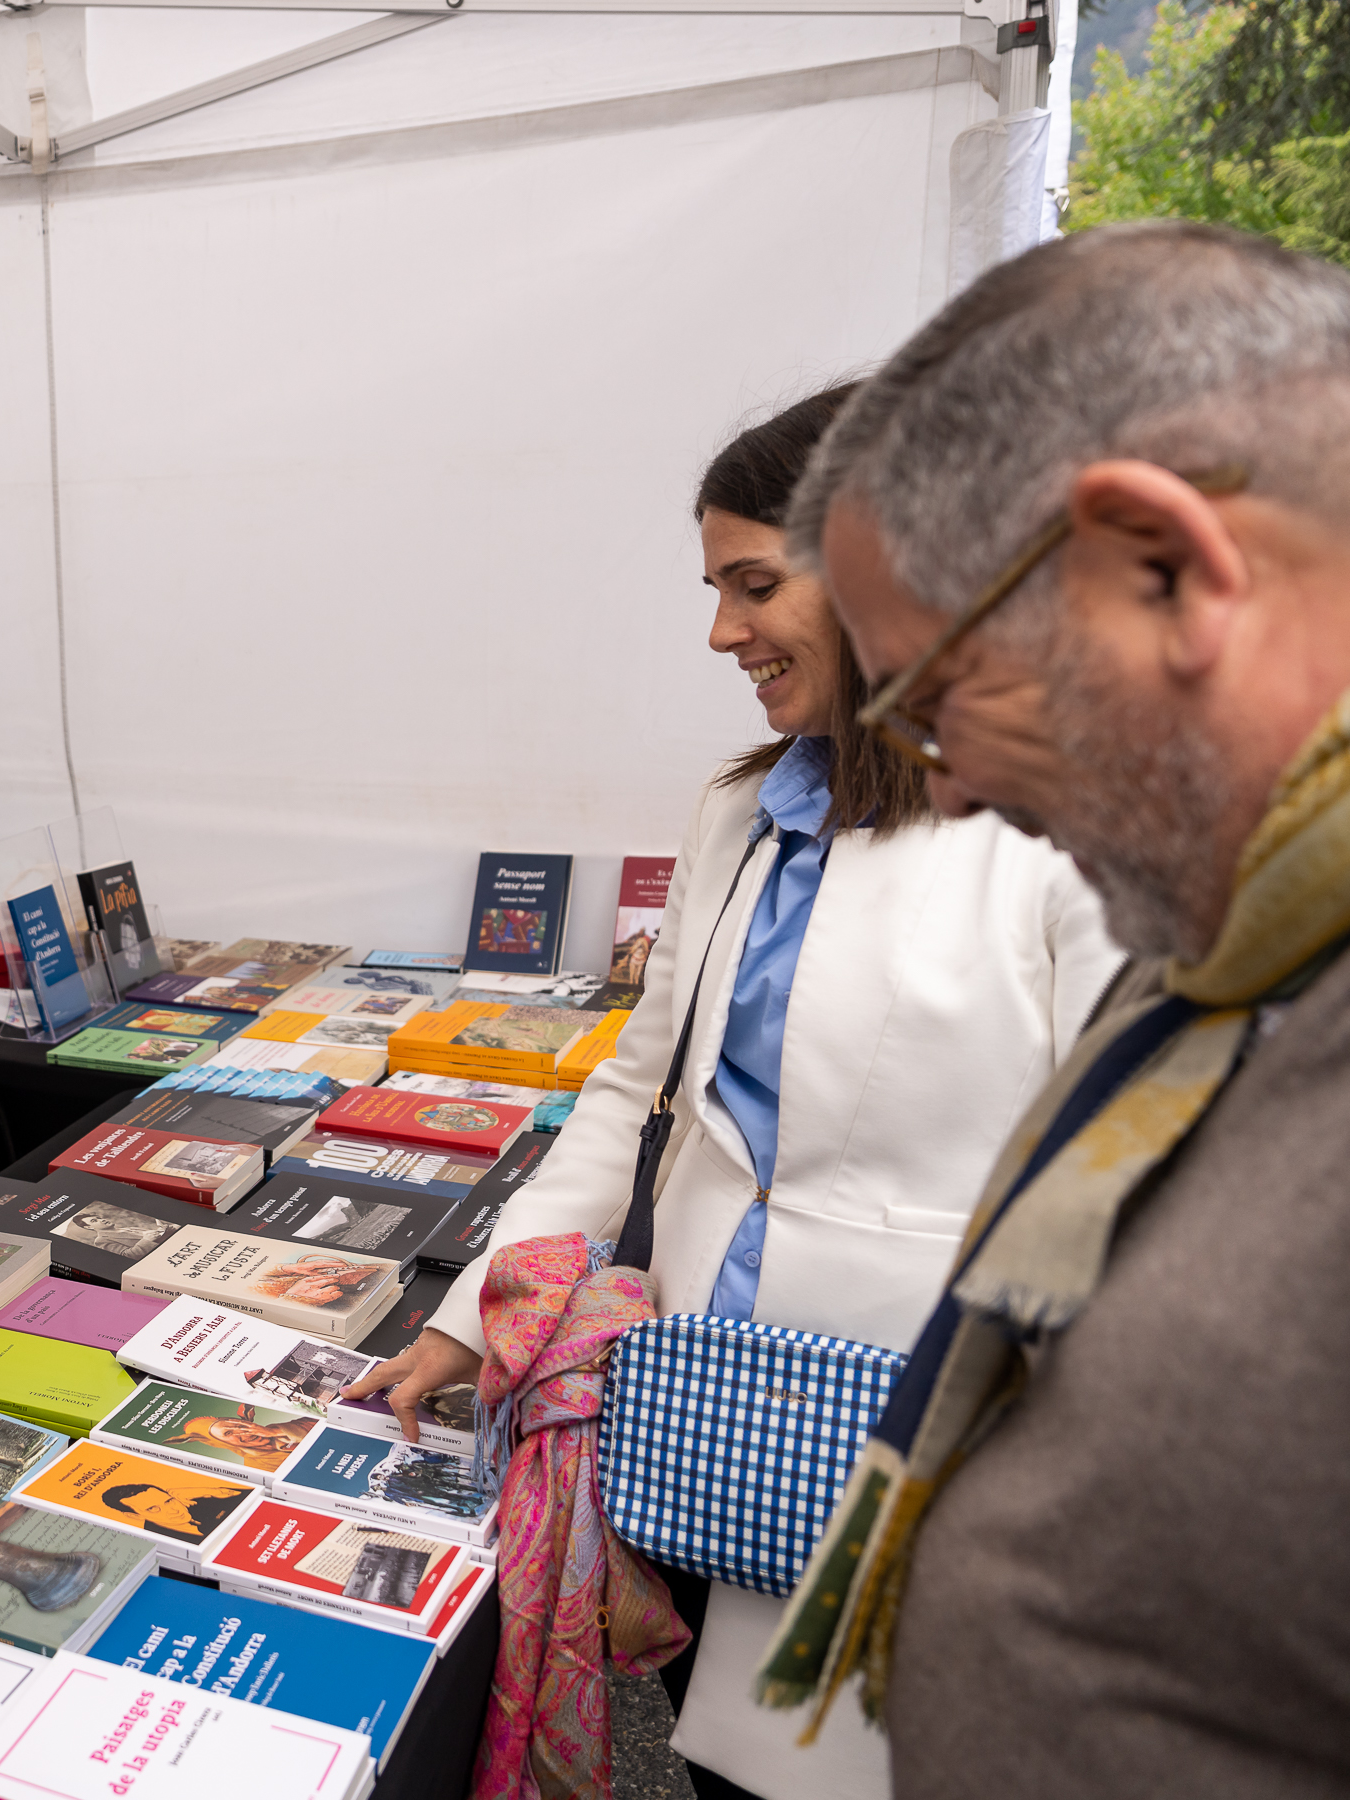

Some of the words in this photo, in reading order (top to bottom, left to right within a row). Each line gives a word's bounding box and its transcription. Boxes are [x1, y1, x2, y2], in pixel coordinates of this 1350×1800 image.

[494, 881, 522, 891] sense
[522, 882, 545, 892] nom
[497, 868, 546, 880] Passaport
[100, 889, 115, 914] La
[23, 912, 31, 922] El
[74, 1151, 95, 1165] Les
[90, 1128, 127, 1156] venjances
[102, 1131, 146, 1160] Talltendre
[305, 1139, 389, 1174] 100
[95, 1157, 111, 1168] de
[371, 1149, 405, 1178] COSES
[19, 1203, 38, 1214] Sergi
[34, 1194, 51, 1204] Mas
[251, 1198, 276, 1218] Andorra
[166, 1241, 202, 1268] L'ART
[224, 1245, 261, 1276] FUSTA
[248, 1306, 263, 1314] L'ART
[402, 1309, 424, 1330] Canillo
[161, 1315, 204, 1350] D'ANDORRA
[177, 1332, 208, 1358] BESIERS
[206, 1314, 227, 1330] ALBI
[218, 1350, 236, 1364] Simone
[233, 1336, 249, 1351] Torres
[141, 1399, 173, 1428] PERDONEU
[148, 1423, 162, 1434] LES
[160, 1398, 189, 1425] DISCULPES
[440, 1435, 461, 1446] CARRER
[221, 1468, 249, 1480] PERDONEU
[332, 1463, 342, 1474] LA
[338, 1453, 354, 1468] NEU
[343, 1454, 369, 1480] ADVERSA
[74, 1489, 88, 1500] REI
[85, 1461, 124, 1492] D'ANDORRA
[371, 1509, 396, 1521] ADVERSA
[396, 1516, 408, 1524] NEU
[257, 1549, 272, 1564] SET
[268, 1518, 299, 1554] LLETANIES
[276, 1546, 289, 1560] DE
[284, 1530, 306, 1551] MORT
[122, 1656, 146, 1672] El
[138, 1624, 169, 1660] camí
[156, 1658, 184, 1680] cap
[172, 1647, 186, 1658] a
[180, 1634, 198, 1650] la
[181, 1616, 242, 1688] Constitució
[210, 1632, 266, 1698] d'Andorra
[89, 1688, 156, 1764] Paisatges
[108, 1772, 136, 1796] de
[122, 1754, 148, 1773] la
[141, 1699, 187, 1754] utopia
